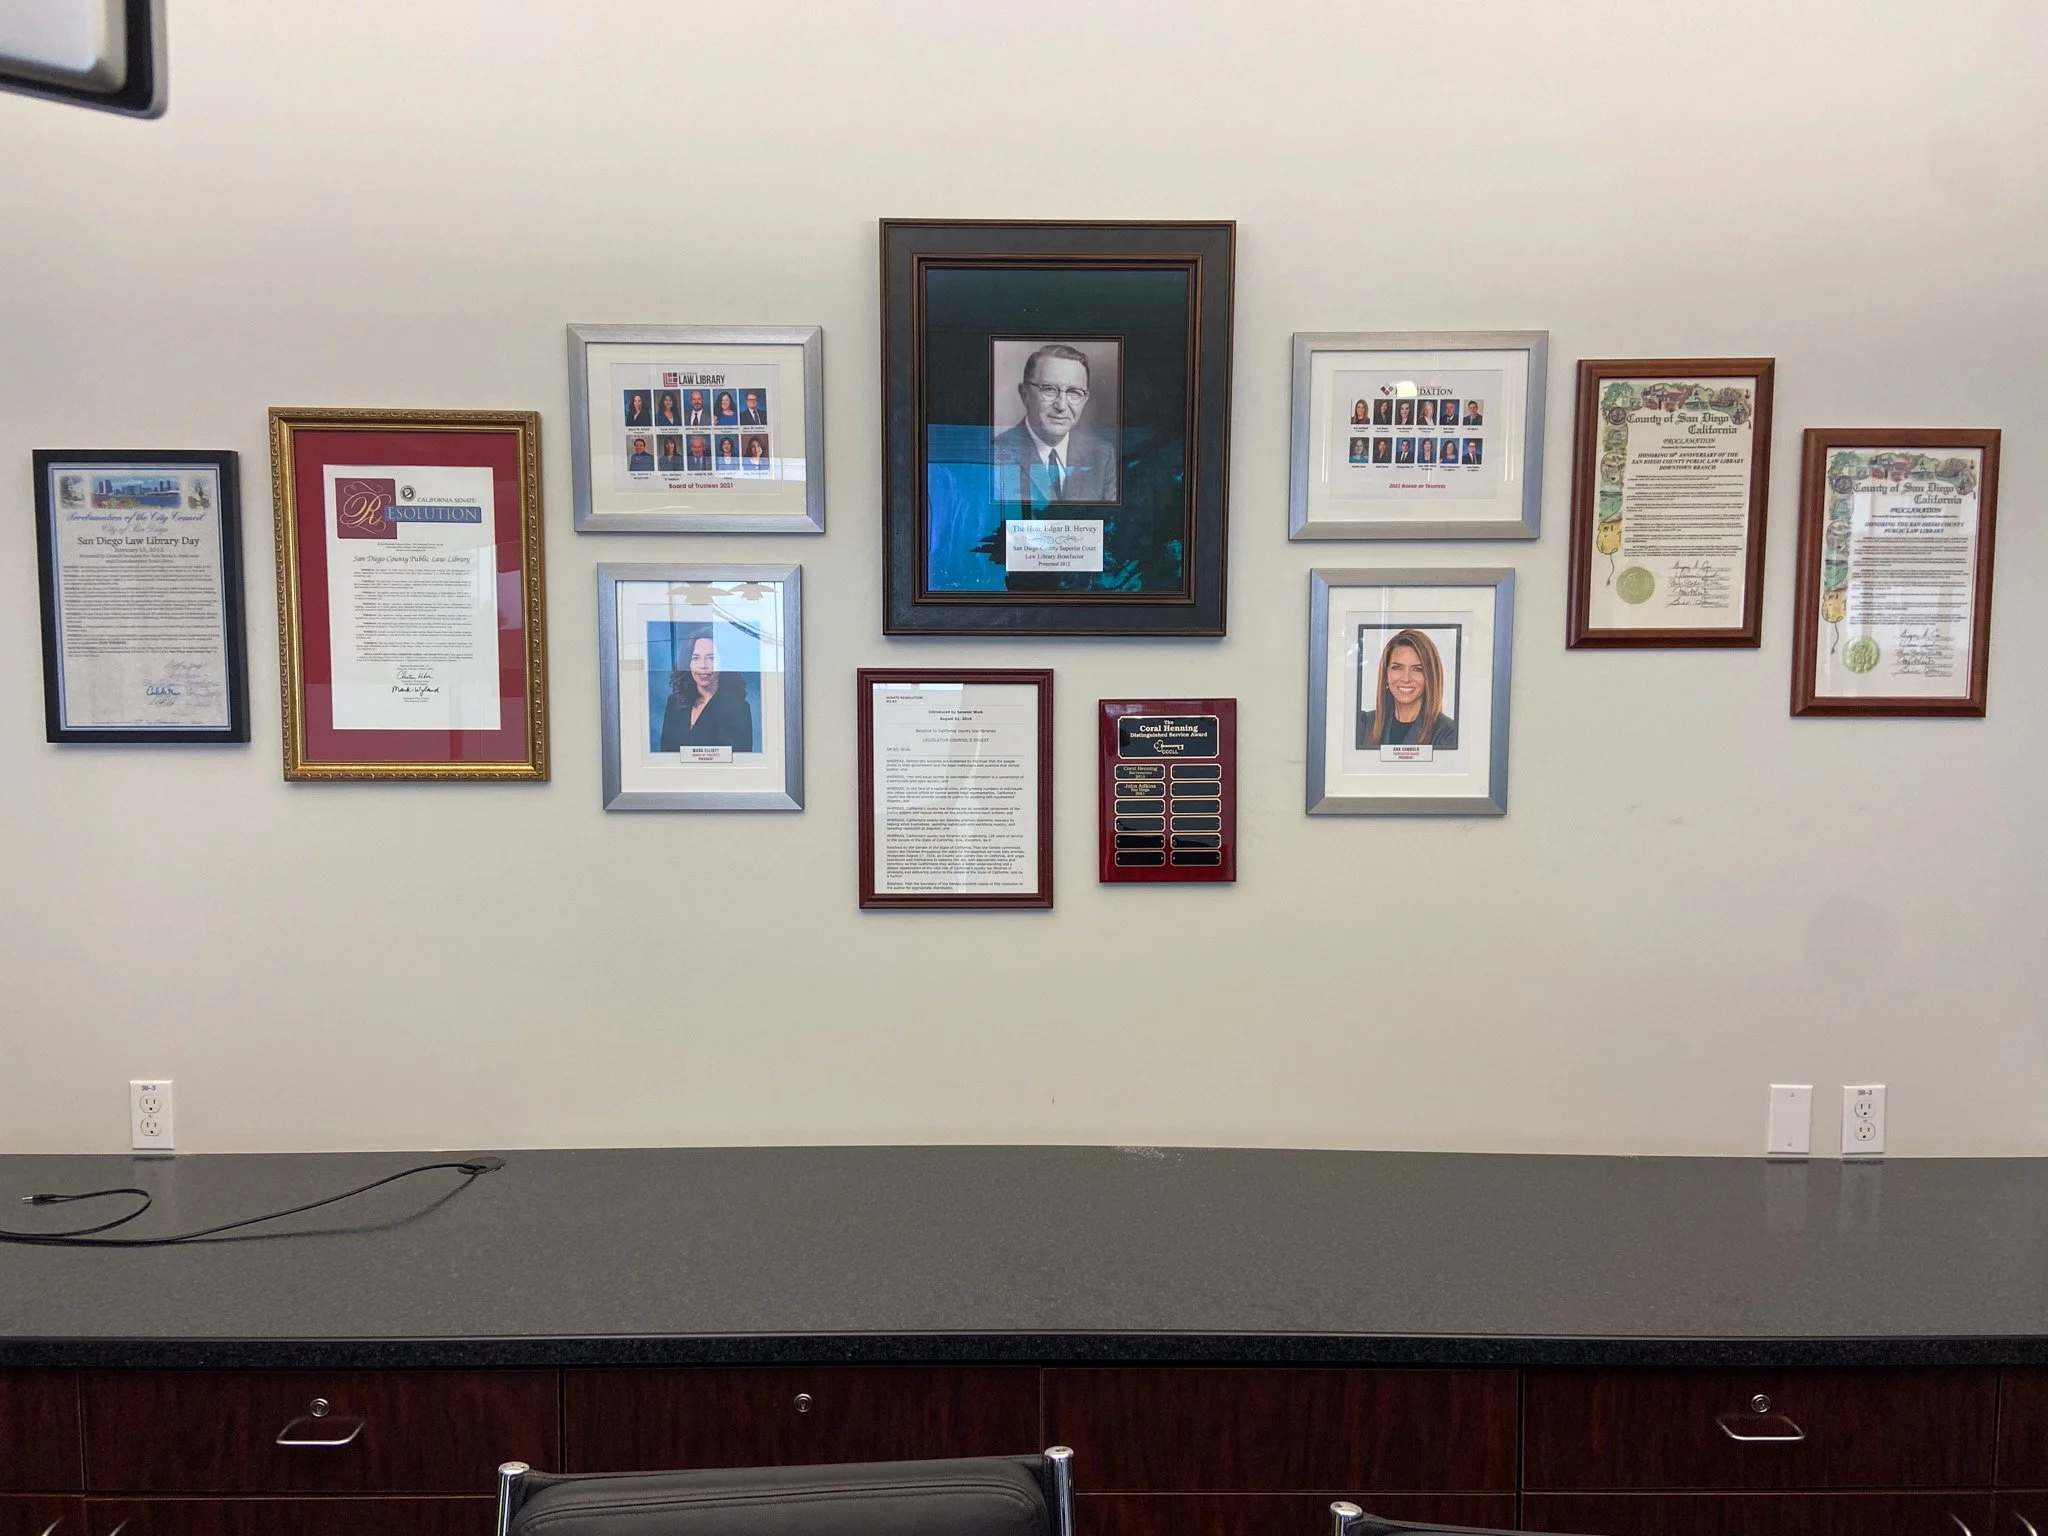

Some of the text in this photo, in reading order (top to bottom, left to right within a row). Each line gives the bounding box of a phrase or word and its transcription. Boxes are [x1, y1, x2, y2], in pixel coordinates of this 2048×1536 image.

[679, 374, 725, 385] LAW LIBRARY
[1626, 413, 1729, 426] County of San Diego
[1688, 424, 1737, 435] California
[1852, 483, 1954, 495] County of San Diego
[1913, 494, 1962, 504] California
[1044, 525, 1063, 533] Edgar
[1073, 525, 1097, 533] Hervey
[77, 536, 200, 547] San Diego Law Library Day
[367, 555, 385, 564] Diego
[386, 555, 409, 564] County
[447, 556, 471, 564] Library
[1164, 725, 1199, 733] Henning
